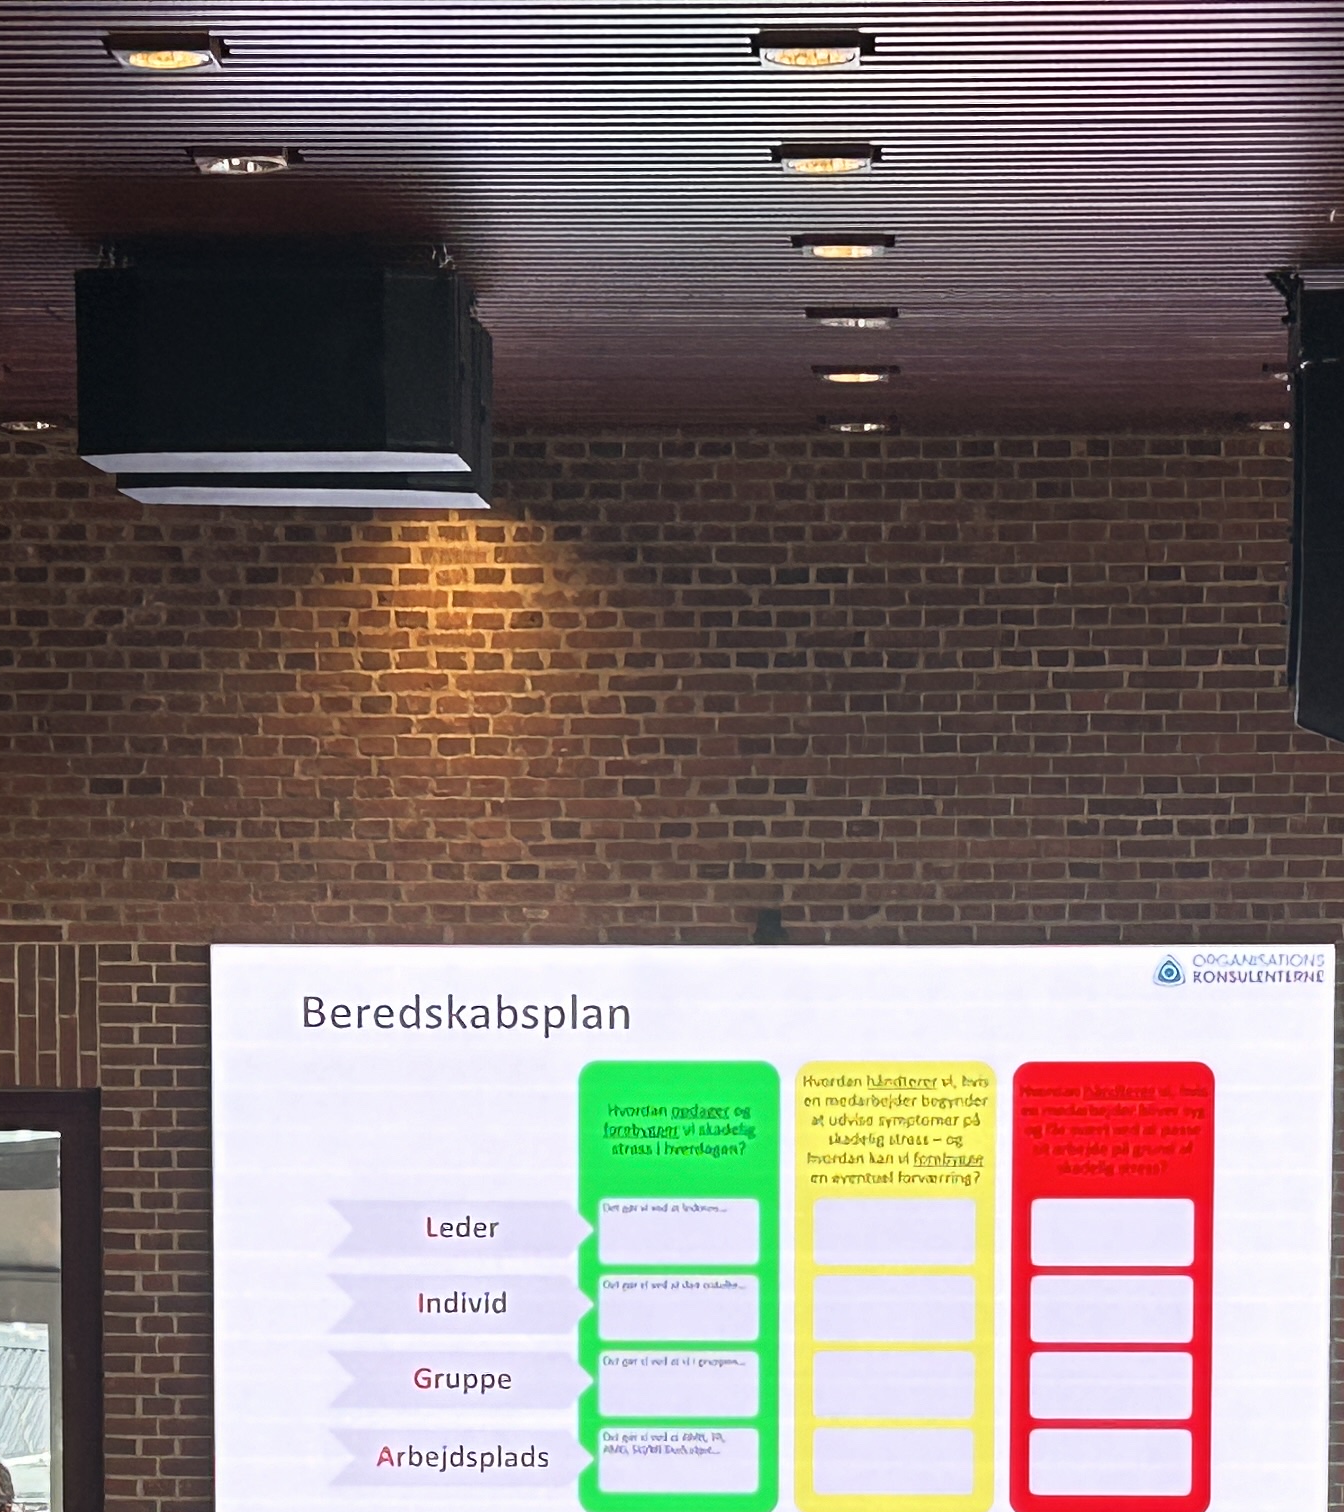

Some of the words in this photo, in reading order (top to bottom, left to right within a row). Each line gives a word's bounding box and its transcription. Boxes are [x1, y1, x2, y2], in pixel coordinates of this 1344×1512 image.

[1193, 970, 1325, 983] KONSULENTERNE
[302, 993, 632, 1039] Beredskabsplan
[803, 1075, 862, 1088] Hvordan
[804, 1096, 821, 1107] en
[825, 1094, 917, 1110] medarbejder
[921, 1094, 989, 1110] begynder
[608, 1104, 667, 1118] Hvordan
[963, 1112, 981, 1129] på
[946, 1135, 964, 1148] og
[810, 1173, 828, 1184] en
[426, 1215, 499, 1238] Leder
[418, 1290, 507, 1314] Individ
[413, 1367, 512, 1394] Gruppe
[376, 1445, 549, 1473] Arbejdsplads
